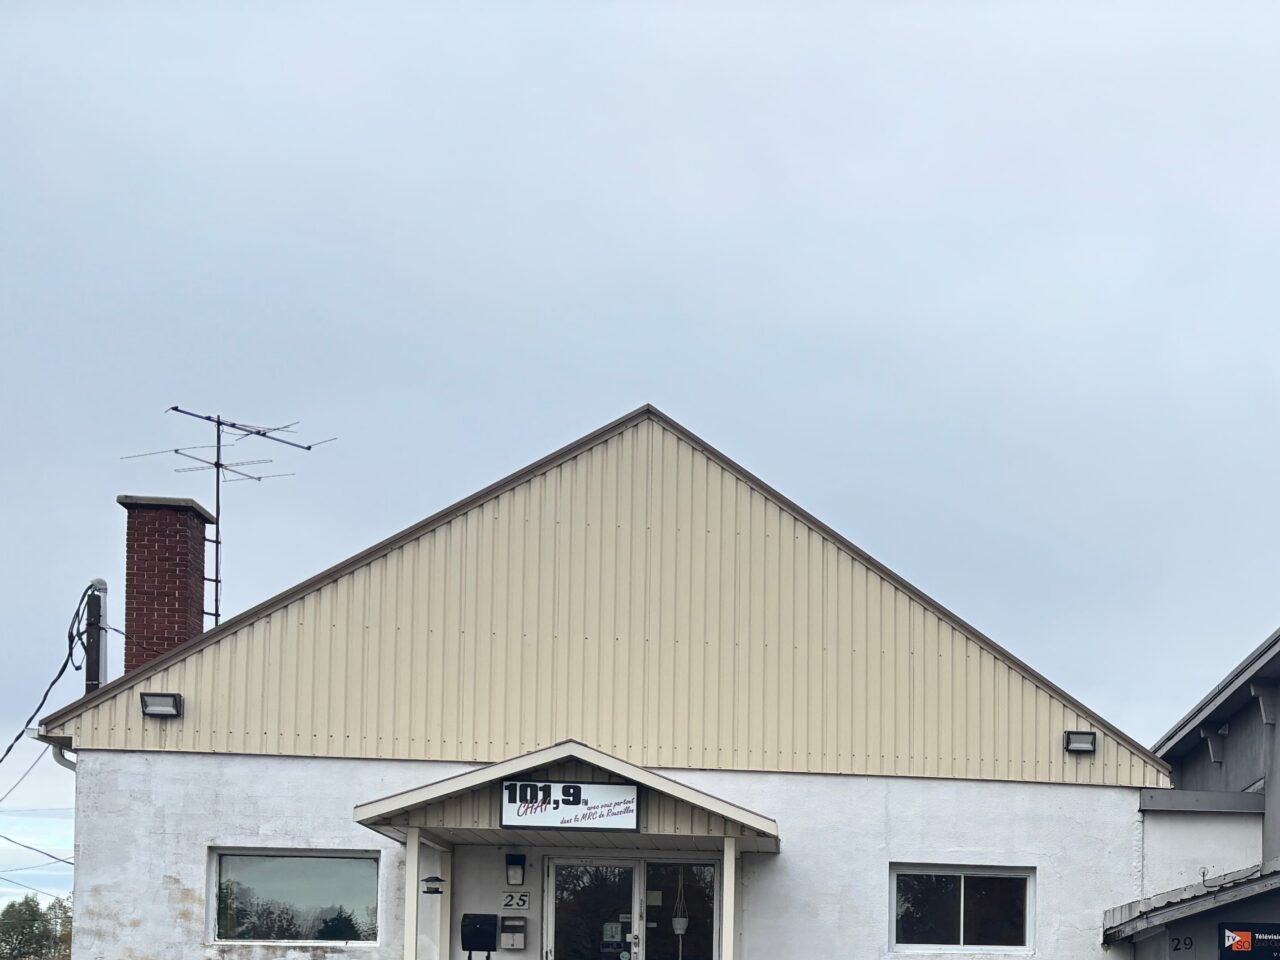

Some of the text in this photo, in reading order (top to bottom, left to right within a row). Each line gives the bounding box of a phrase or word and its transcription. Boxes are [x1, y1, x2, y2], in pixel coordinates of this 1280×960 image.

[504, 783, 581, 810] 101,9
[613, 798, 635, 809] partout
[580, 811, 597, 822] MRC
[504, 894, 528, 907] 25
[1172, 936, 1193, 951] 29
[1236, 941, 1250, 949] SO
